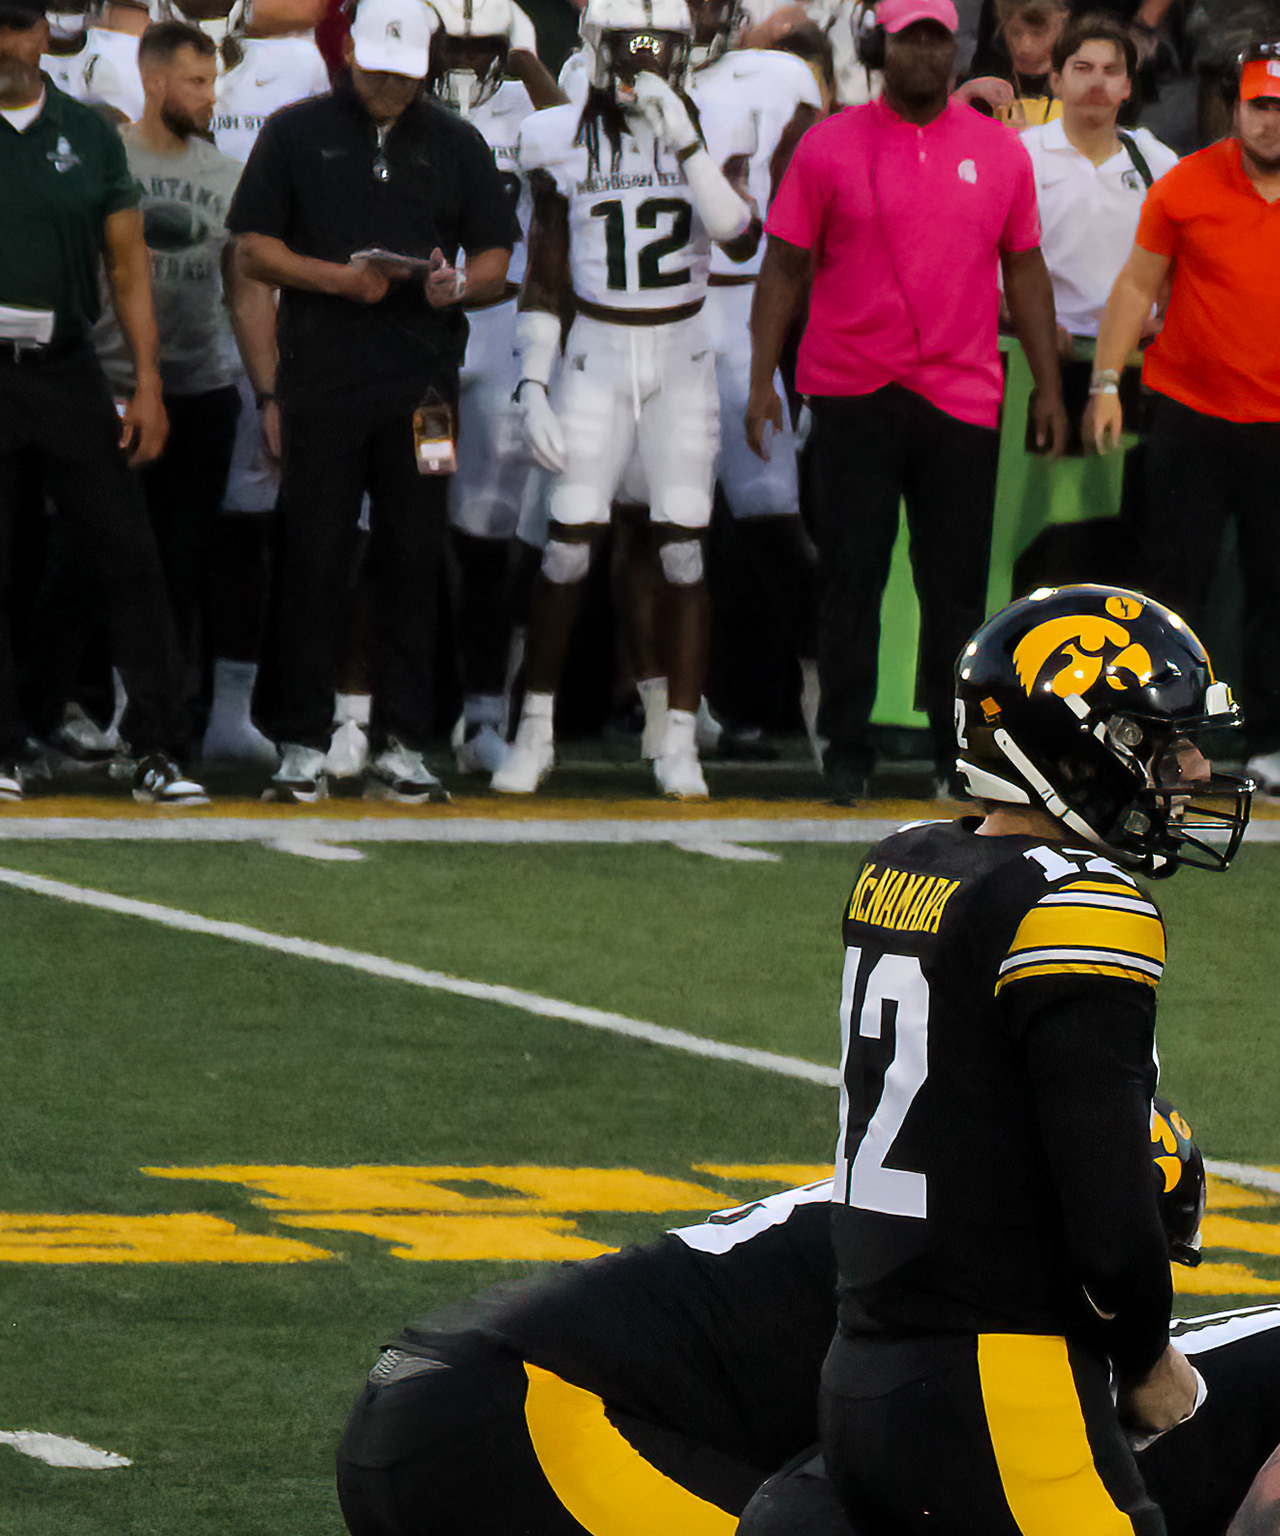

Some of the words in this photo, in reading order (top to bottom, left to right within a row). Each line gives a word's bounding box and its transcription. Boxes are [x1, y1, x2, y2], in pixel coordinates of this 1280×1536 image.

[589, 197, 693, 291] 12
[1021, 843, 1139, 889] 12
[831, 945, 930, 1219] 12
